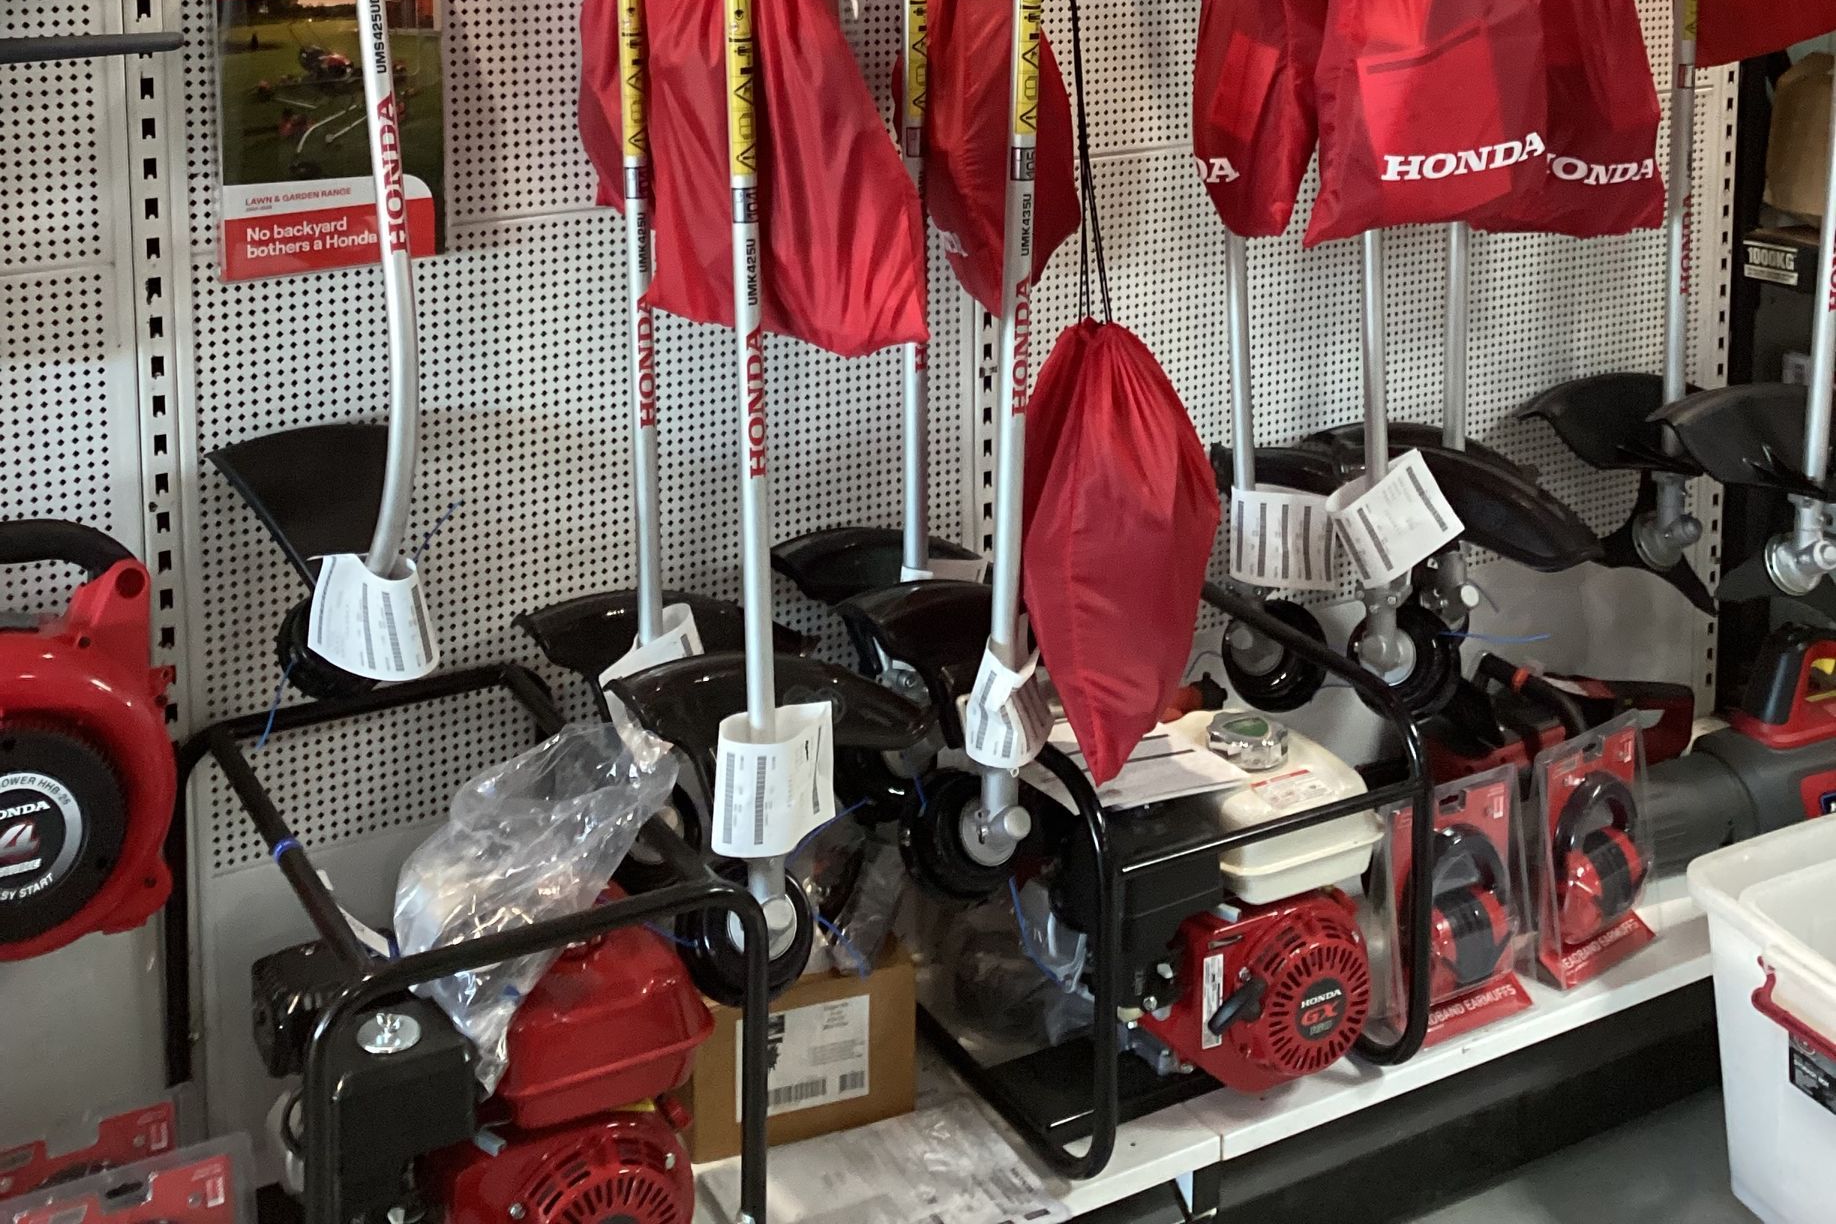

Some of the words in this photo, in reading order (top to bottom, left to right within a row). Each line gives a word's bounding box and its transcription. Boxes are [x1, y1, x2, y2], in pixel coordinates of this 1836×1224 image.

[377, 91, 407, 256] HONDA
[1380, 130, 1545, 183] HONDA
[1546, 150, 1654, 187] ONDA
[245, 195, 273, 206] LAWN
[274, 194, 281, 203] &
[282, 190, 320, 202] GARDEN
[321, 187, 352, 198] RANGE
[246, 227, 270, 242] No
[274, 216, 348, 240] backyard
[247, 240, 310, 259] bothers
[313, 240, 322, 251] a
[326, 229, 378, 249] Honda
[637, 211, 648, 273] UMK425U
[1020, 193, 1032, 257] UMK435U
[746, 238, 759, 306] UMK425U
[637, 291, 656, 429] HONDA
[1011, 273, 1031, 417] HONDA
[746, 326, 767, 480] HONDA
[19, 872, 54, 899] START
[1560, 942, 1599, 970] EADBAND
[1599, 918, 1640, 951] EARMUFFS
[1301, 989, 1342, 1009] HONDA
[1301, 999, 1340, 1027] GX
[1464, 984, 1517, 1015] EARMUFFS
